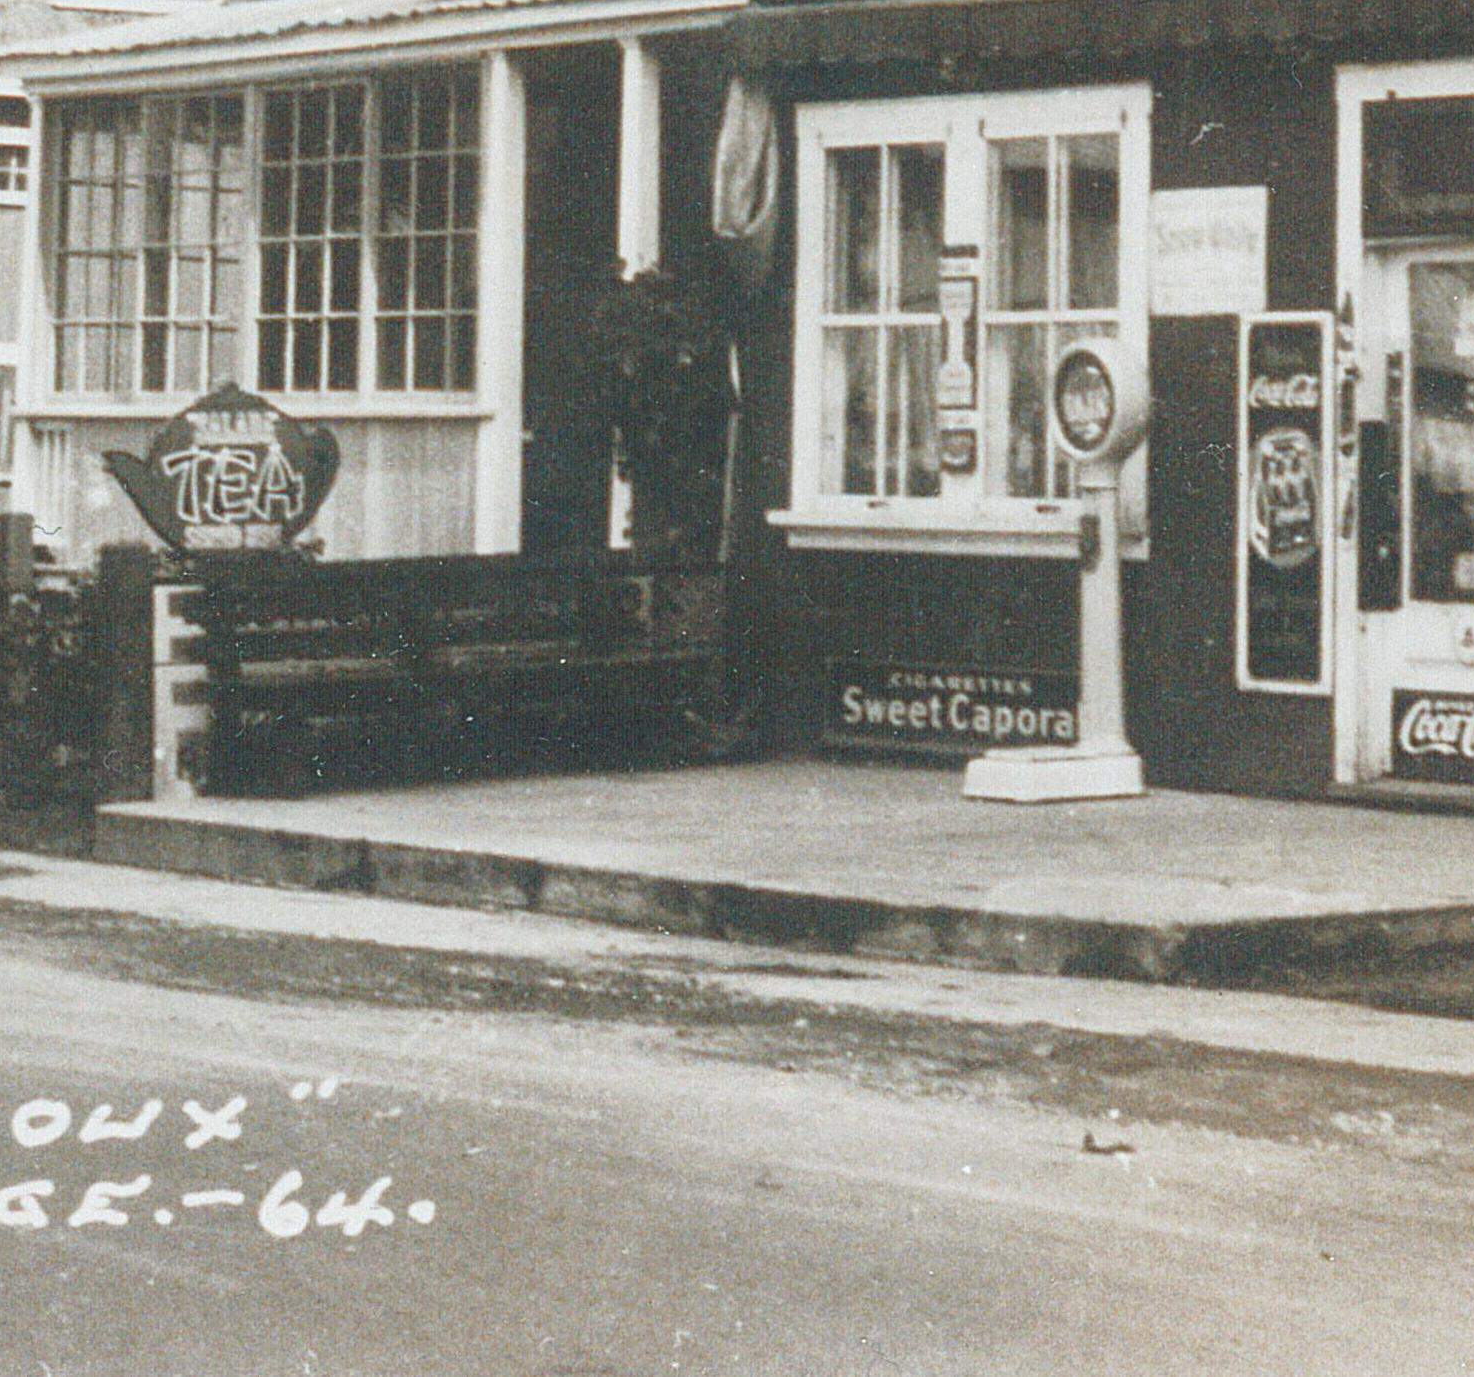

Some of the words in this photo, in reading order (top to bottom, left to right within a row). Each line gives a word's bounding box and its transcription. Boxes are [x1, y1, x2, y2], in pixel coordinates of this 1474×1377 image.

[162, 442, 305, 525] TEA
[842, 684, 943, 729] Sweet
[948, 693, 1075, 739] Capora
